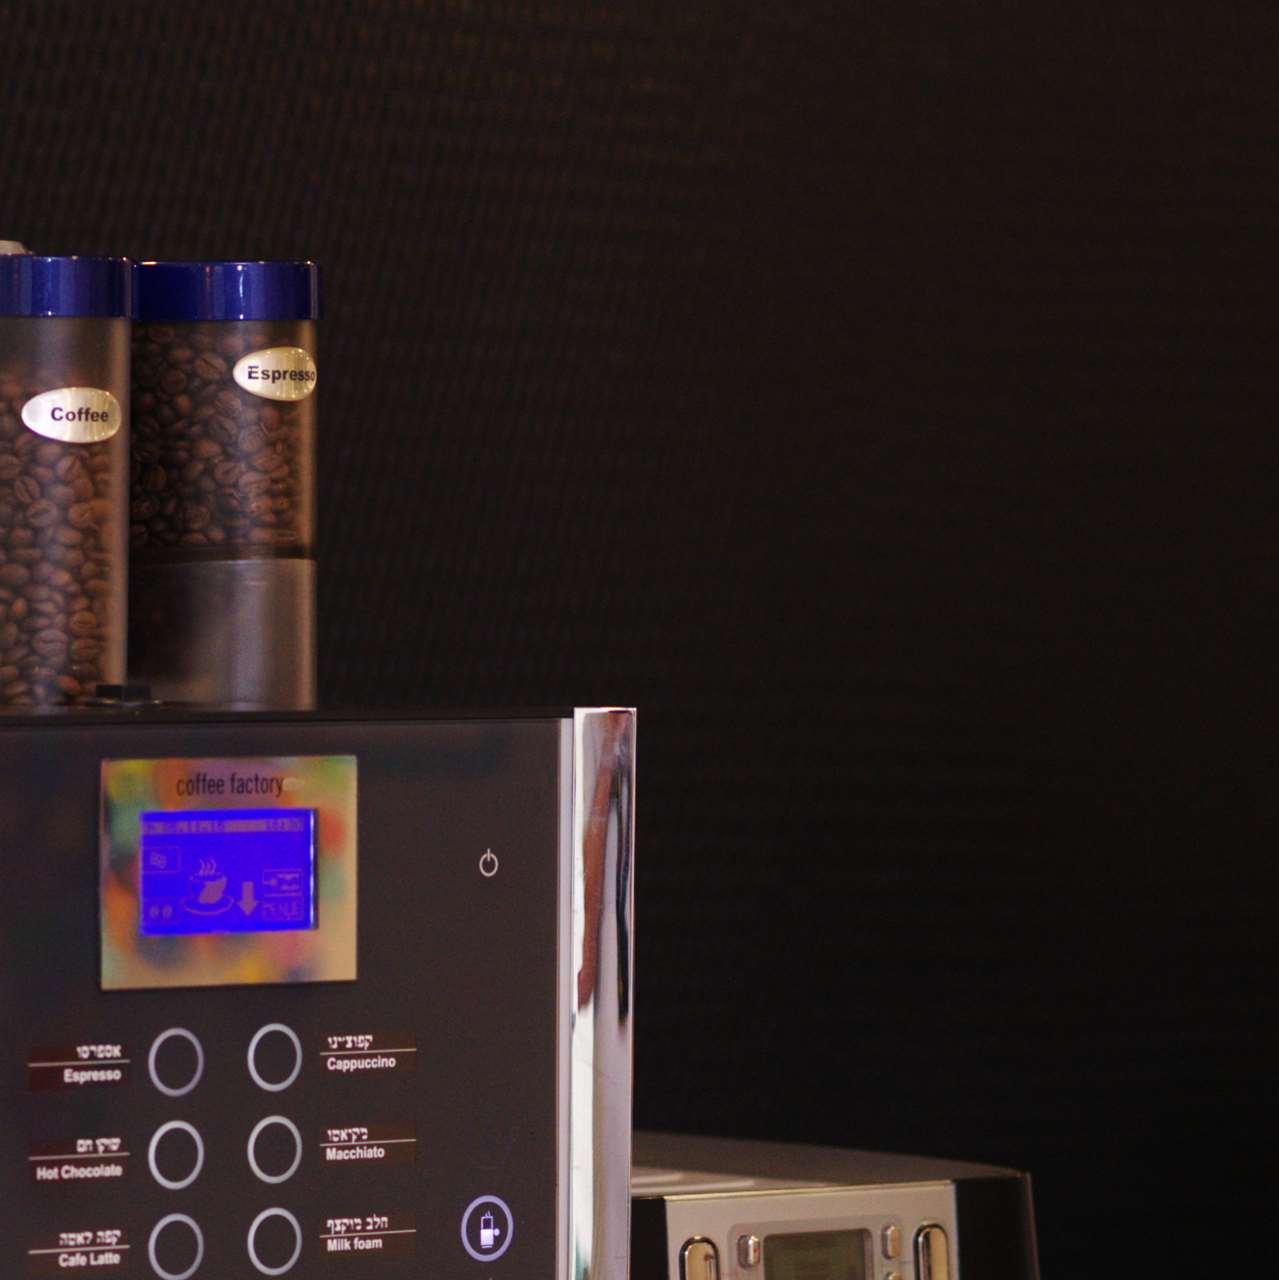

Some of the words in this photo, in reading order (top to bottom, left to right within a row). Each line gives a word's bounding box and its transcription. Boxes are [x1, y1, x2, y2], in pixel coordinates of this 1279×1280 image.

[247, 364, 315, 384] Espresso
[50, 406, 110, 422] Coffee
[176, 773, 225, 796] coffee
[230, 772, 284, 798] factory
[76, 1044, 122, 1059] אספרסו
[326, 1055, 397, 1073] Cappuccino
[63, 1068, 122, 1085] Espresso
[325, 1146, 385, 1161] Macchiato
[35, 1166, 59, 1181] Hot
[60, 1163, 123, 1179] Chocolate
[365, 1213, 388, 1230] חלב
[327, 1238, 351, 1252] Milk
[353, 1236, 383, 1251] foam
[58, 1252, 88, 1267] Cafe
[89, 1251, 121, 1266] Latte
